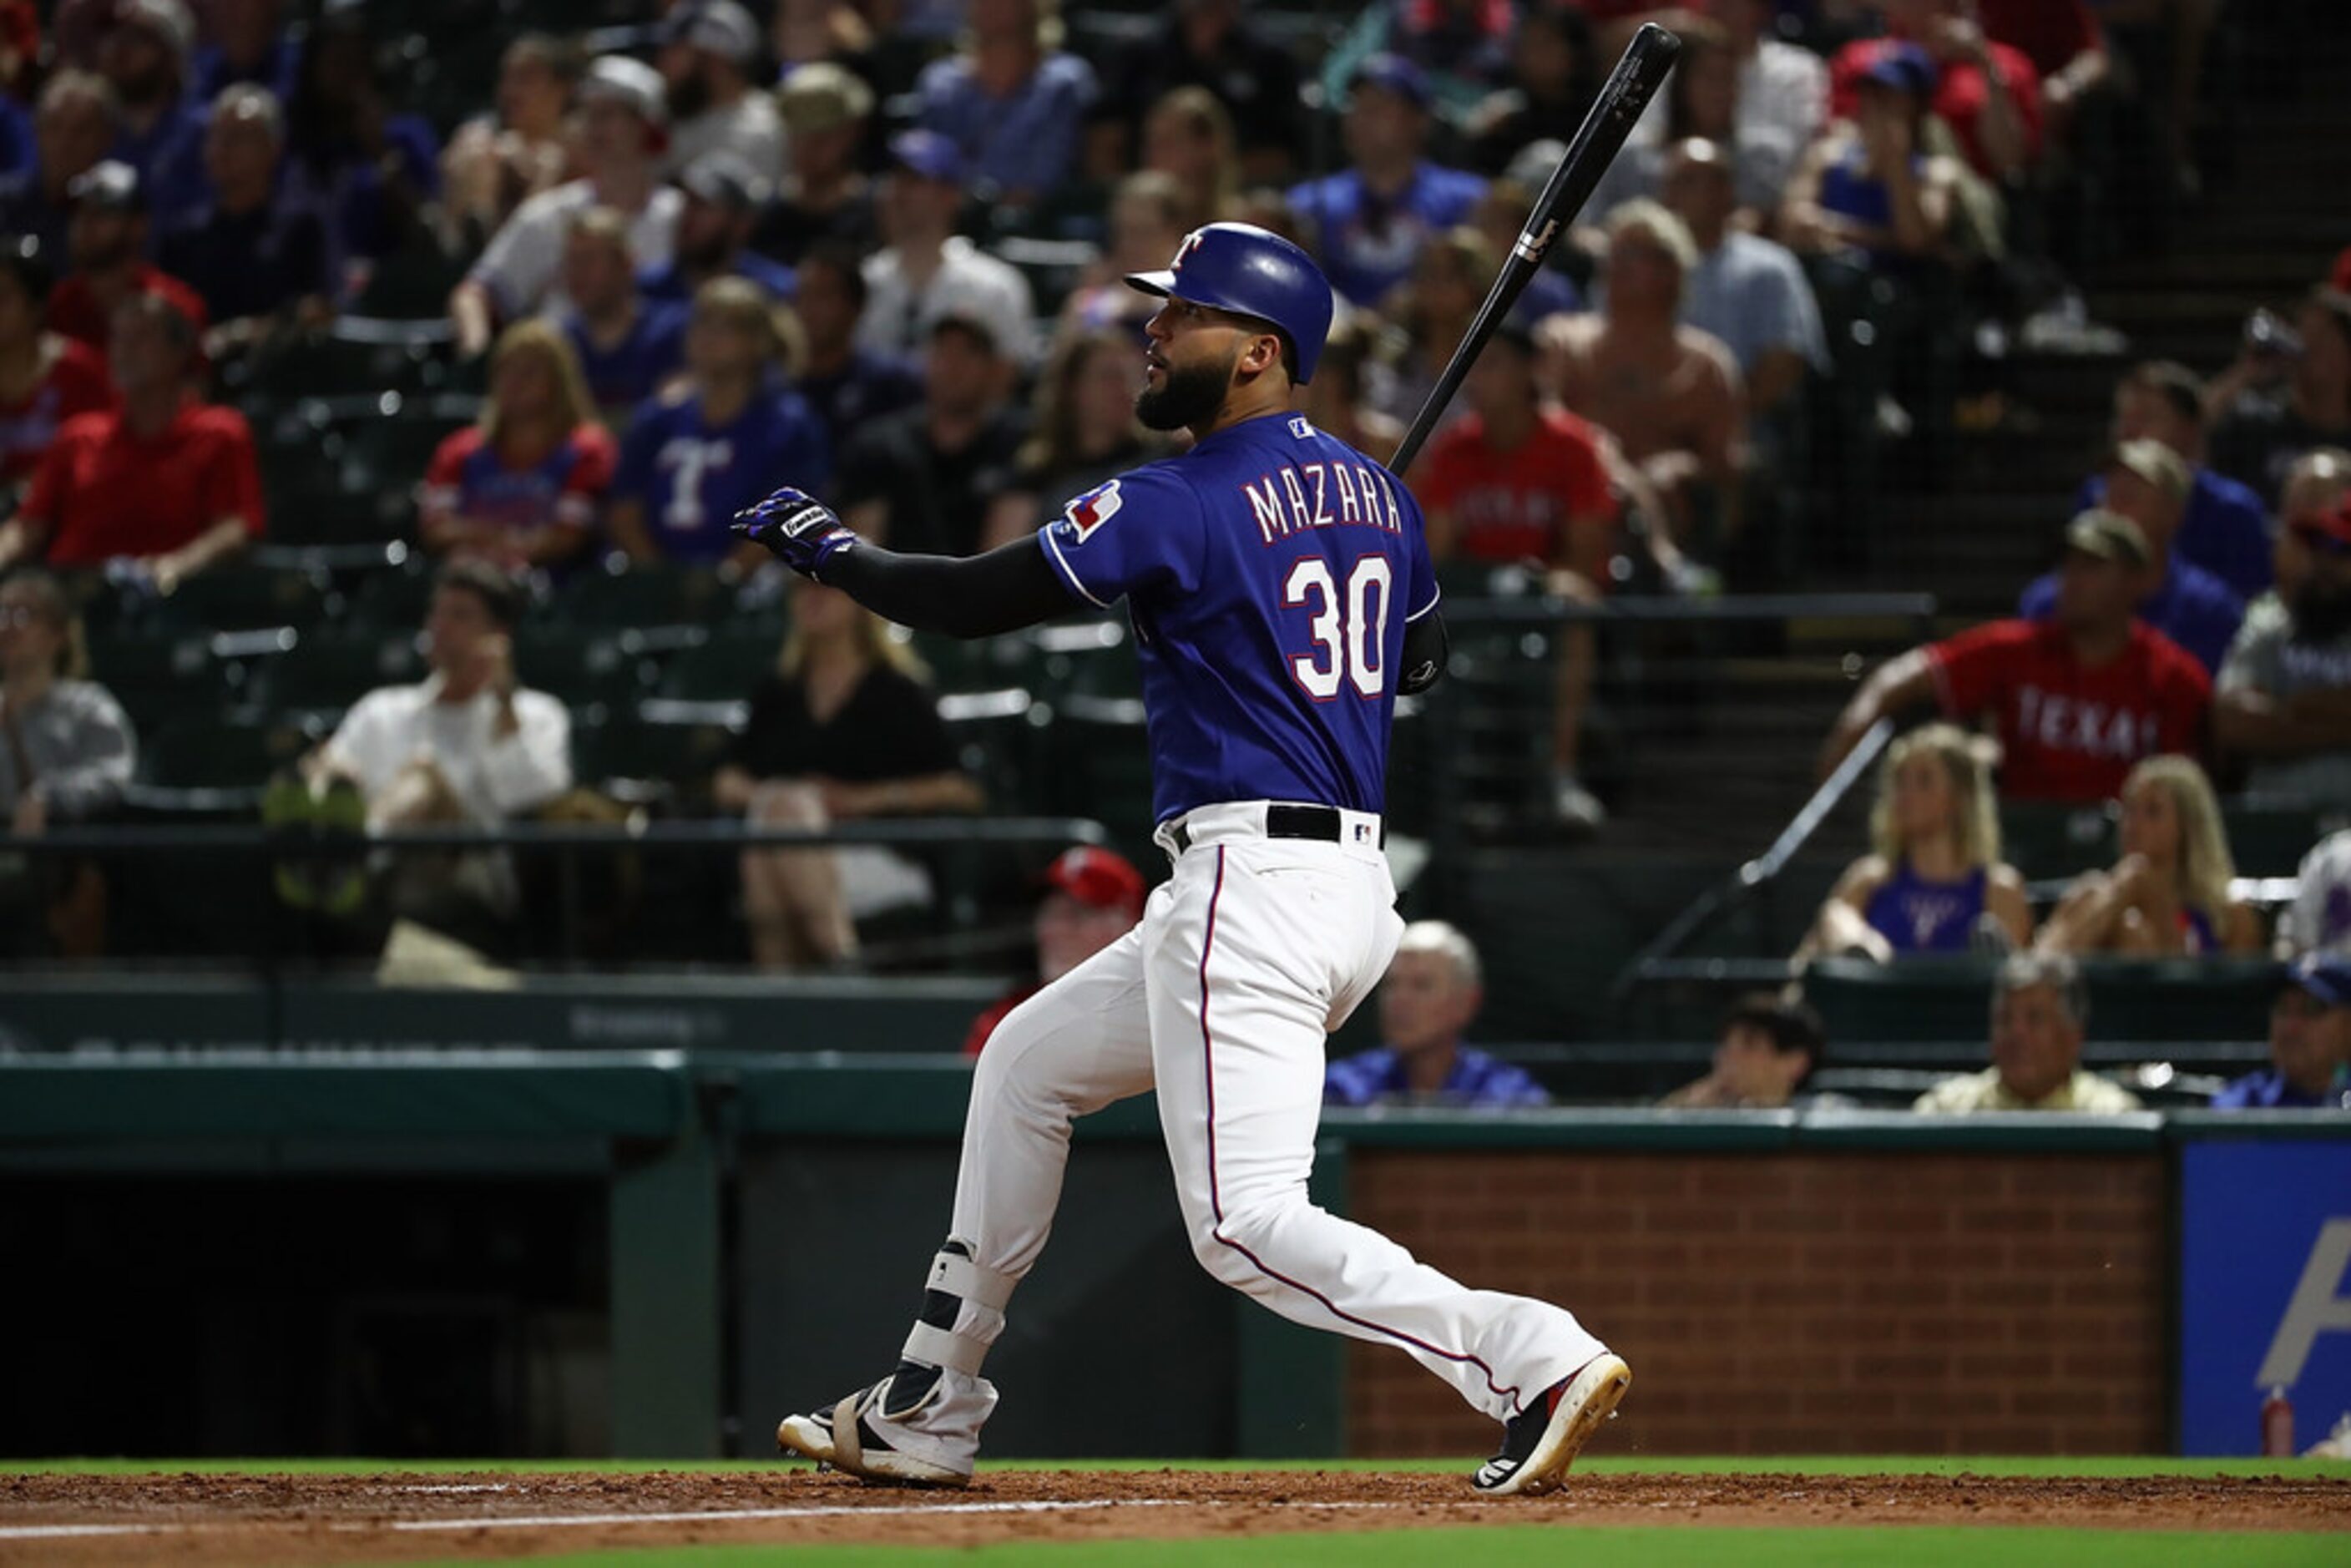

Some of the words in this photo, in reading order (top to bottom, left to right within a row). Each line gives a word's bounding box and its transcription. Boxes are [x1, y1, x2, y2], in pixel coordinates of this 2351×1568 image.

[1170, 232, 1204, 270] T
[655, 435, 734, 529] T
[1241, 461, 1403, 547] MAZARA
[1281, 553, 1393, 703] 30
